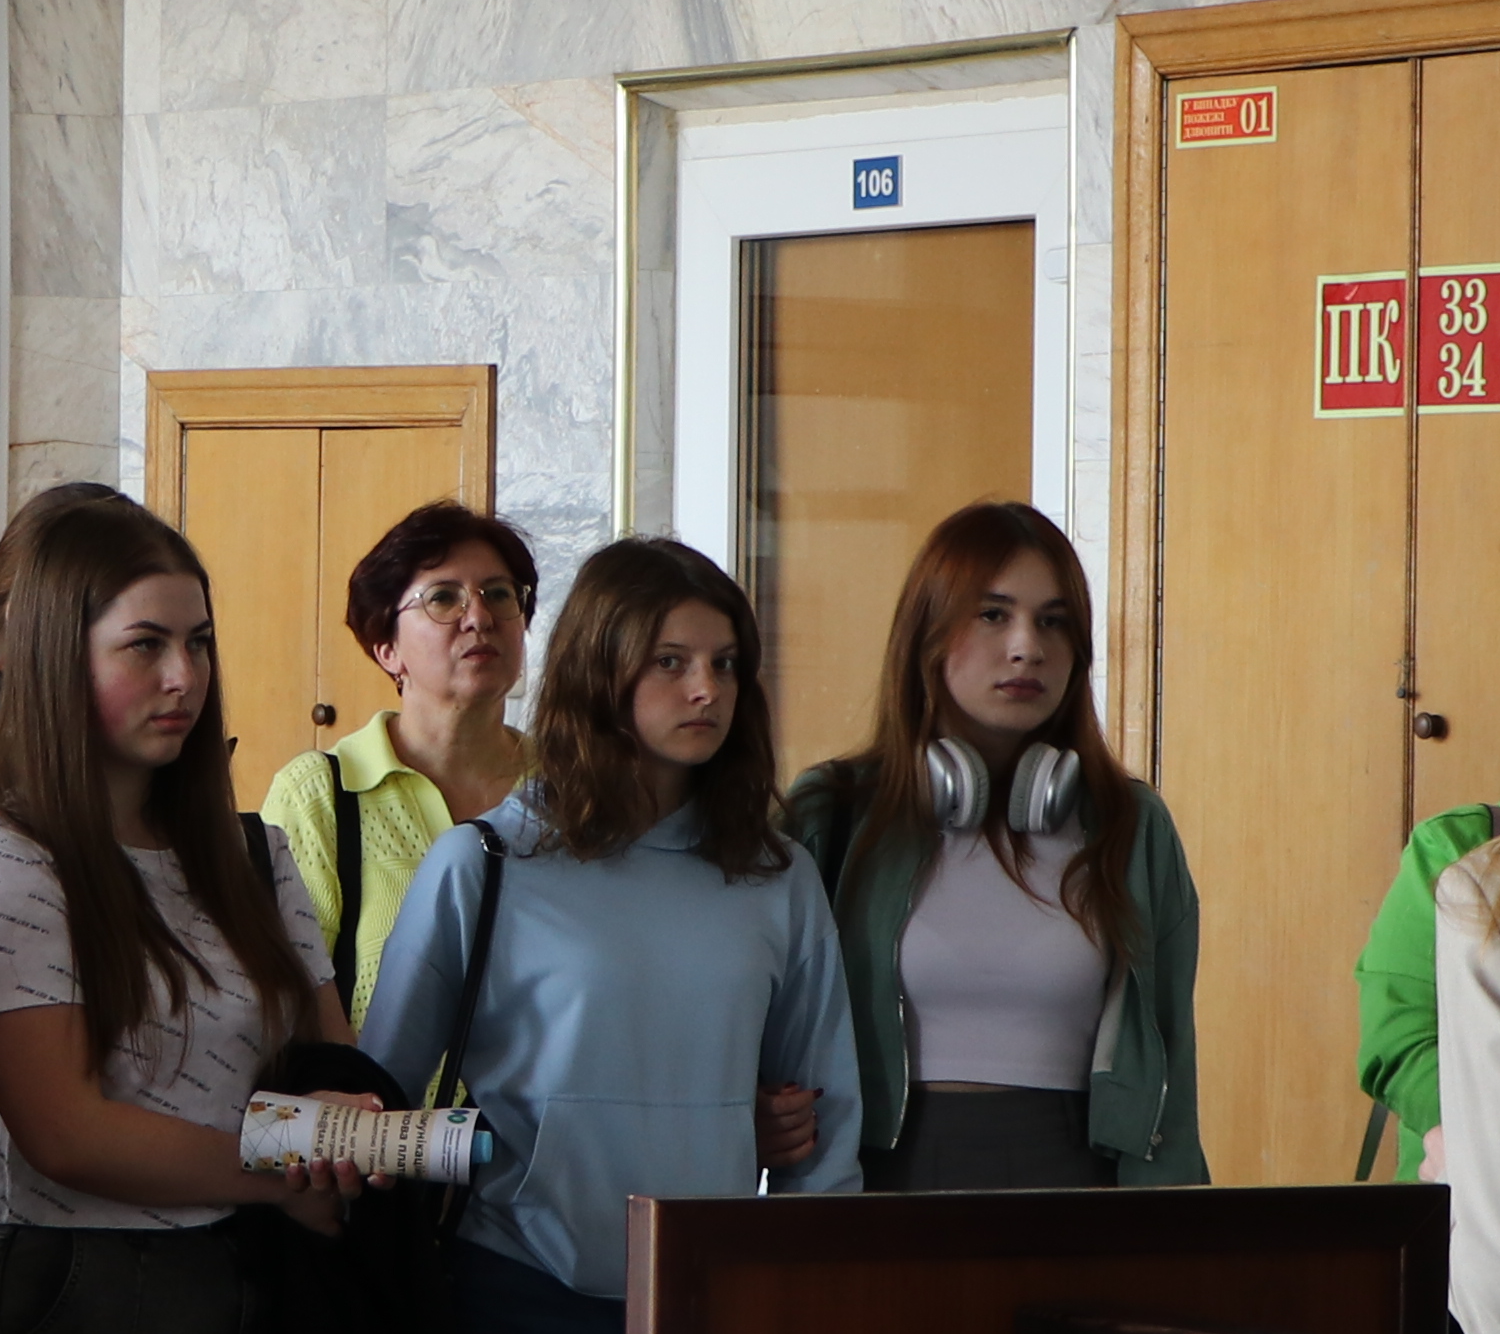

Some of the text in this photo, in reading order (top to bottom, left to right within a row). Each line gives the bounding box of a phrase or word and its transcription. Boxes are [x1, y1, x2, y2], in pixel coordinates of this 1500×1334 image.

[1240, 96, 1271, 134] 01
[857, 168, 894, 198] 106
[1439, 278, 1488, 336] 33
[1324, 298, 1401, 384] ПК
[1437, 341, 1488, 399] 34
